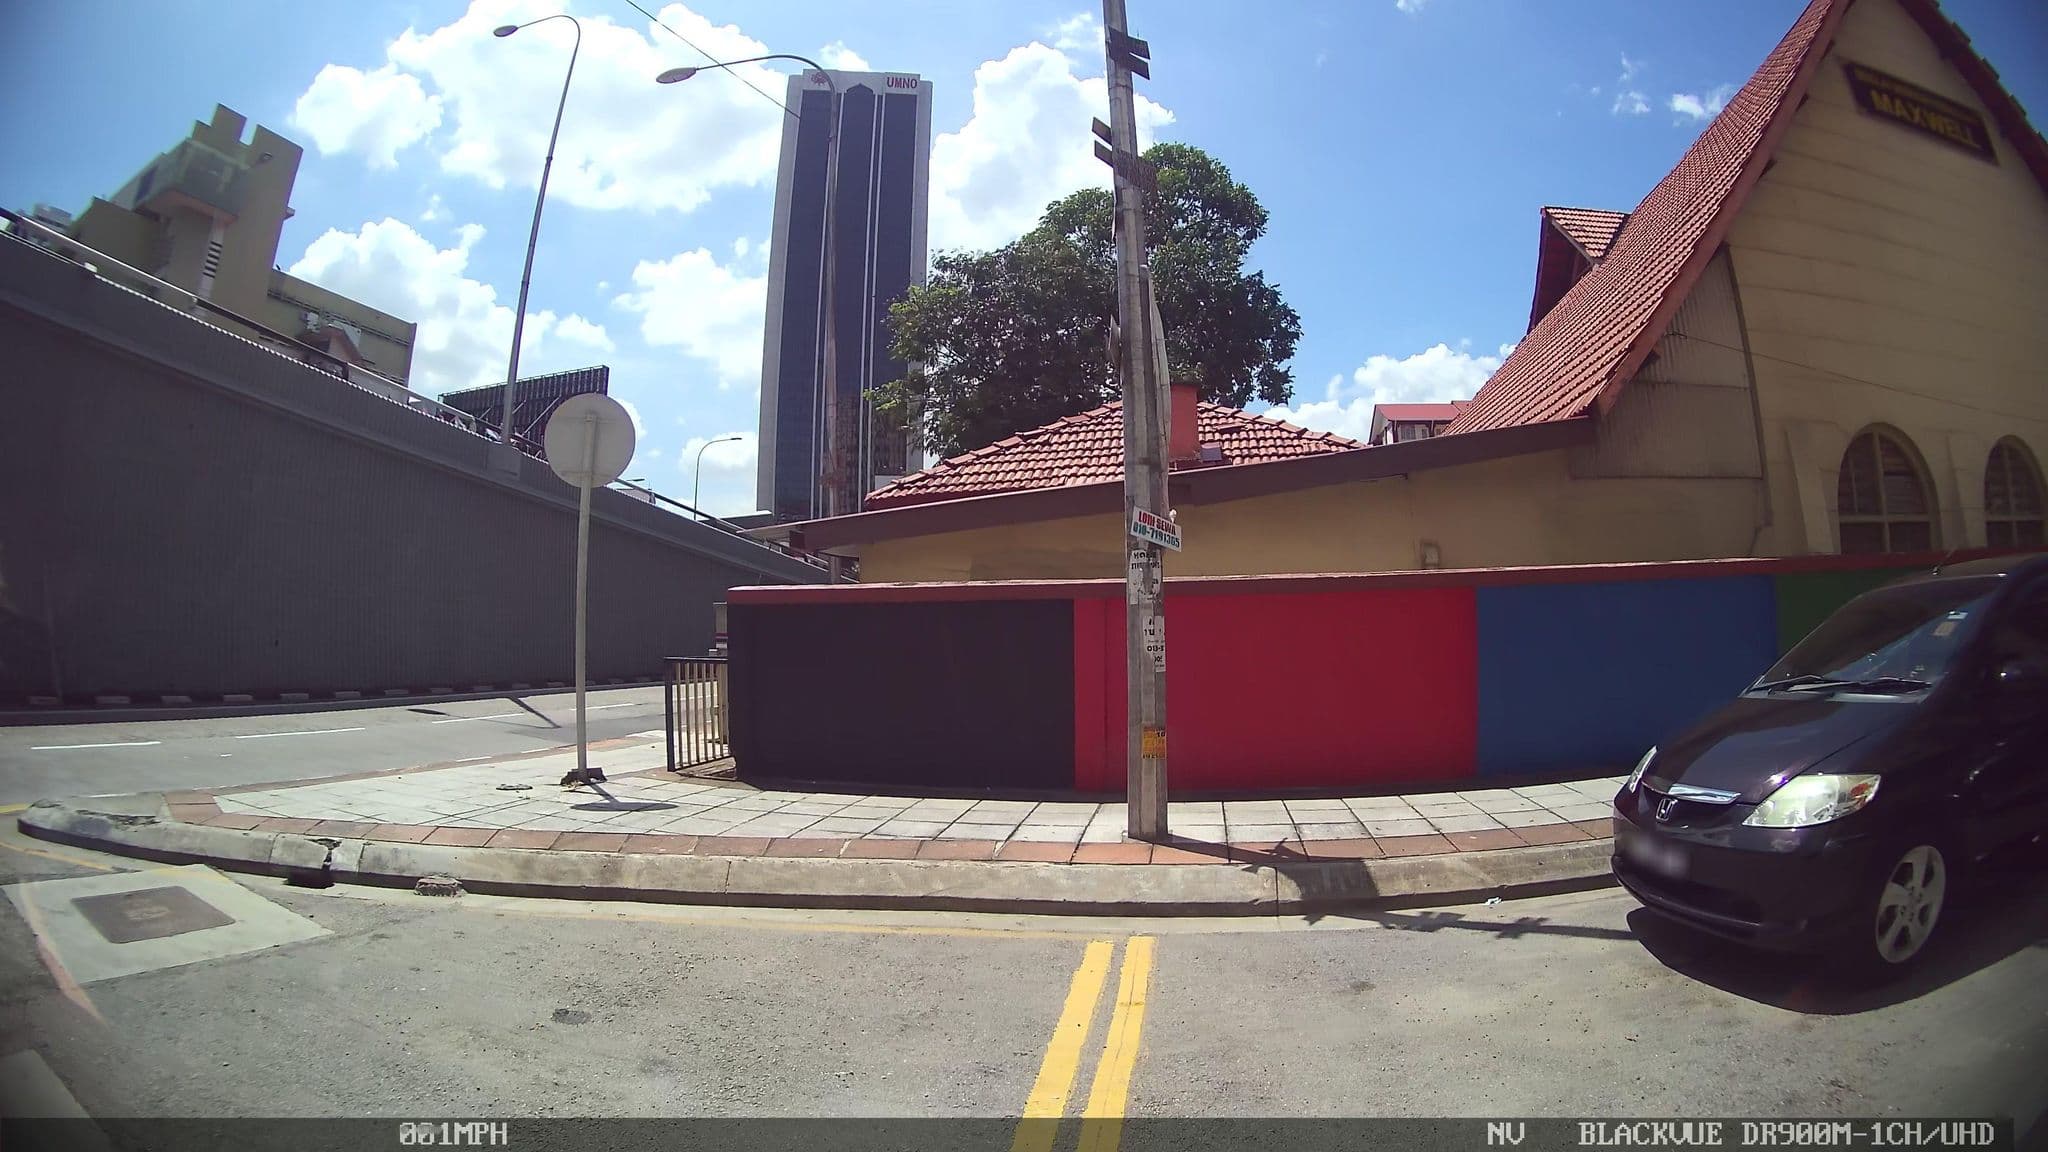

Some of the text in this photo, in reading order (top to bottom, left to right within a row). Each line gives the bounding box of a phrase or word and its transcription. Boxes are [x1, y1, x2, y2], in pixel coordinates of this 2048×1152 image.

[886, 76, 918, 89] UMNO
[1870, 89, 1982, 151] MAXWELL
[1156, 517, 1176, 536] SEWA
